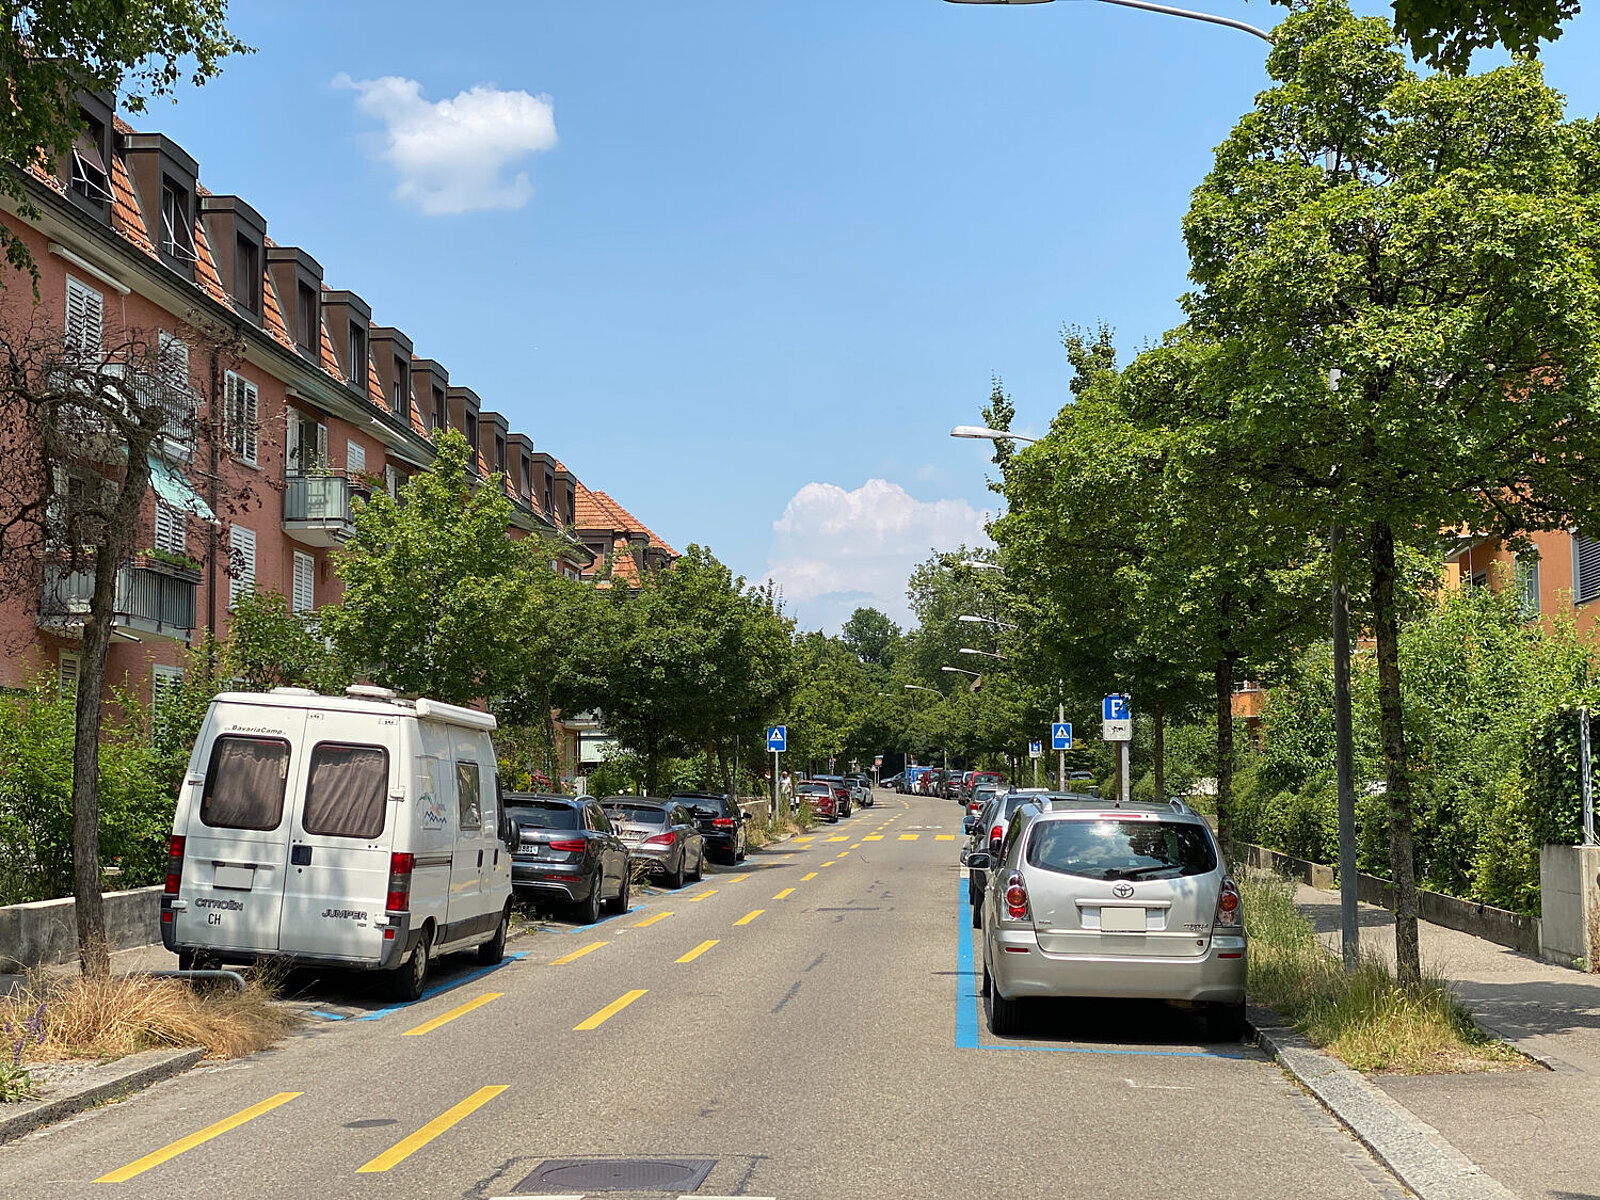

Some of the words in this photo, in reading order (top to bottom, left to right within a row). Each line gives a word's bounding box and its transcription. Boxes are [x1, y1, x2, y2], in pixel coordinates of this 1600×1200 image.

[194, 897, 244, 911] CITROËN
[207, 913, 222, 925] CH
[321, 909, 368, 920] JUMPER
